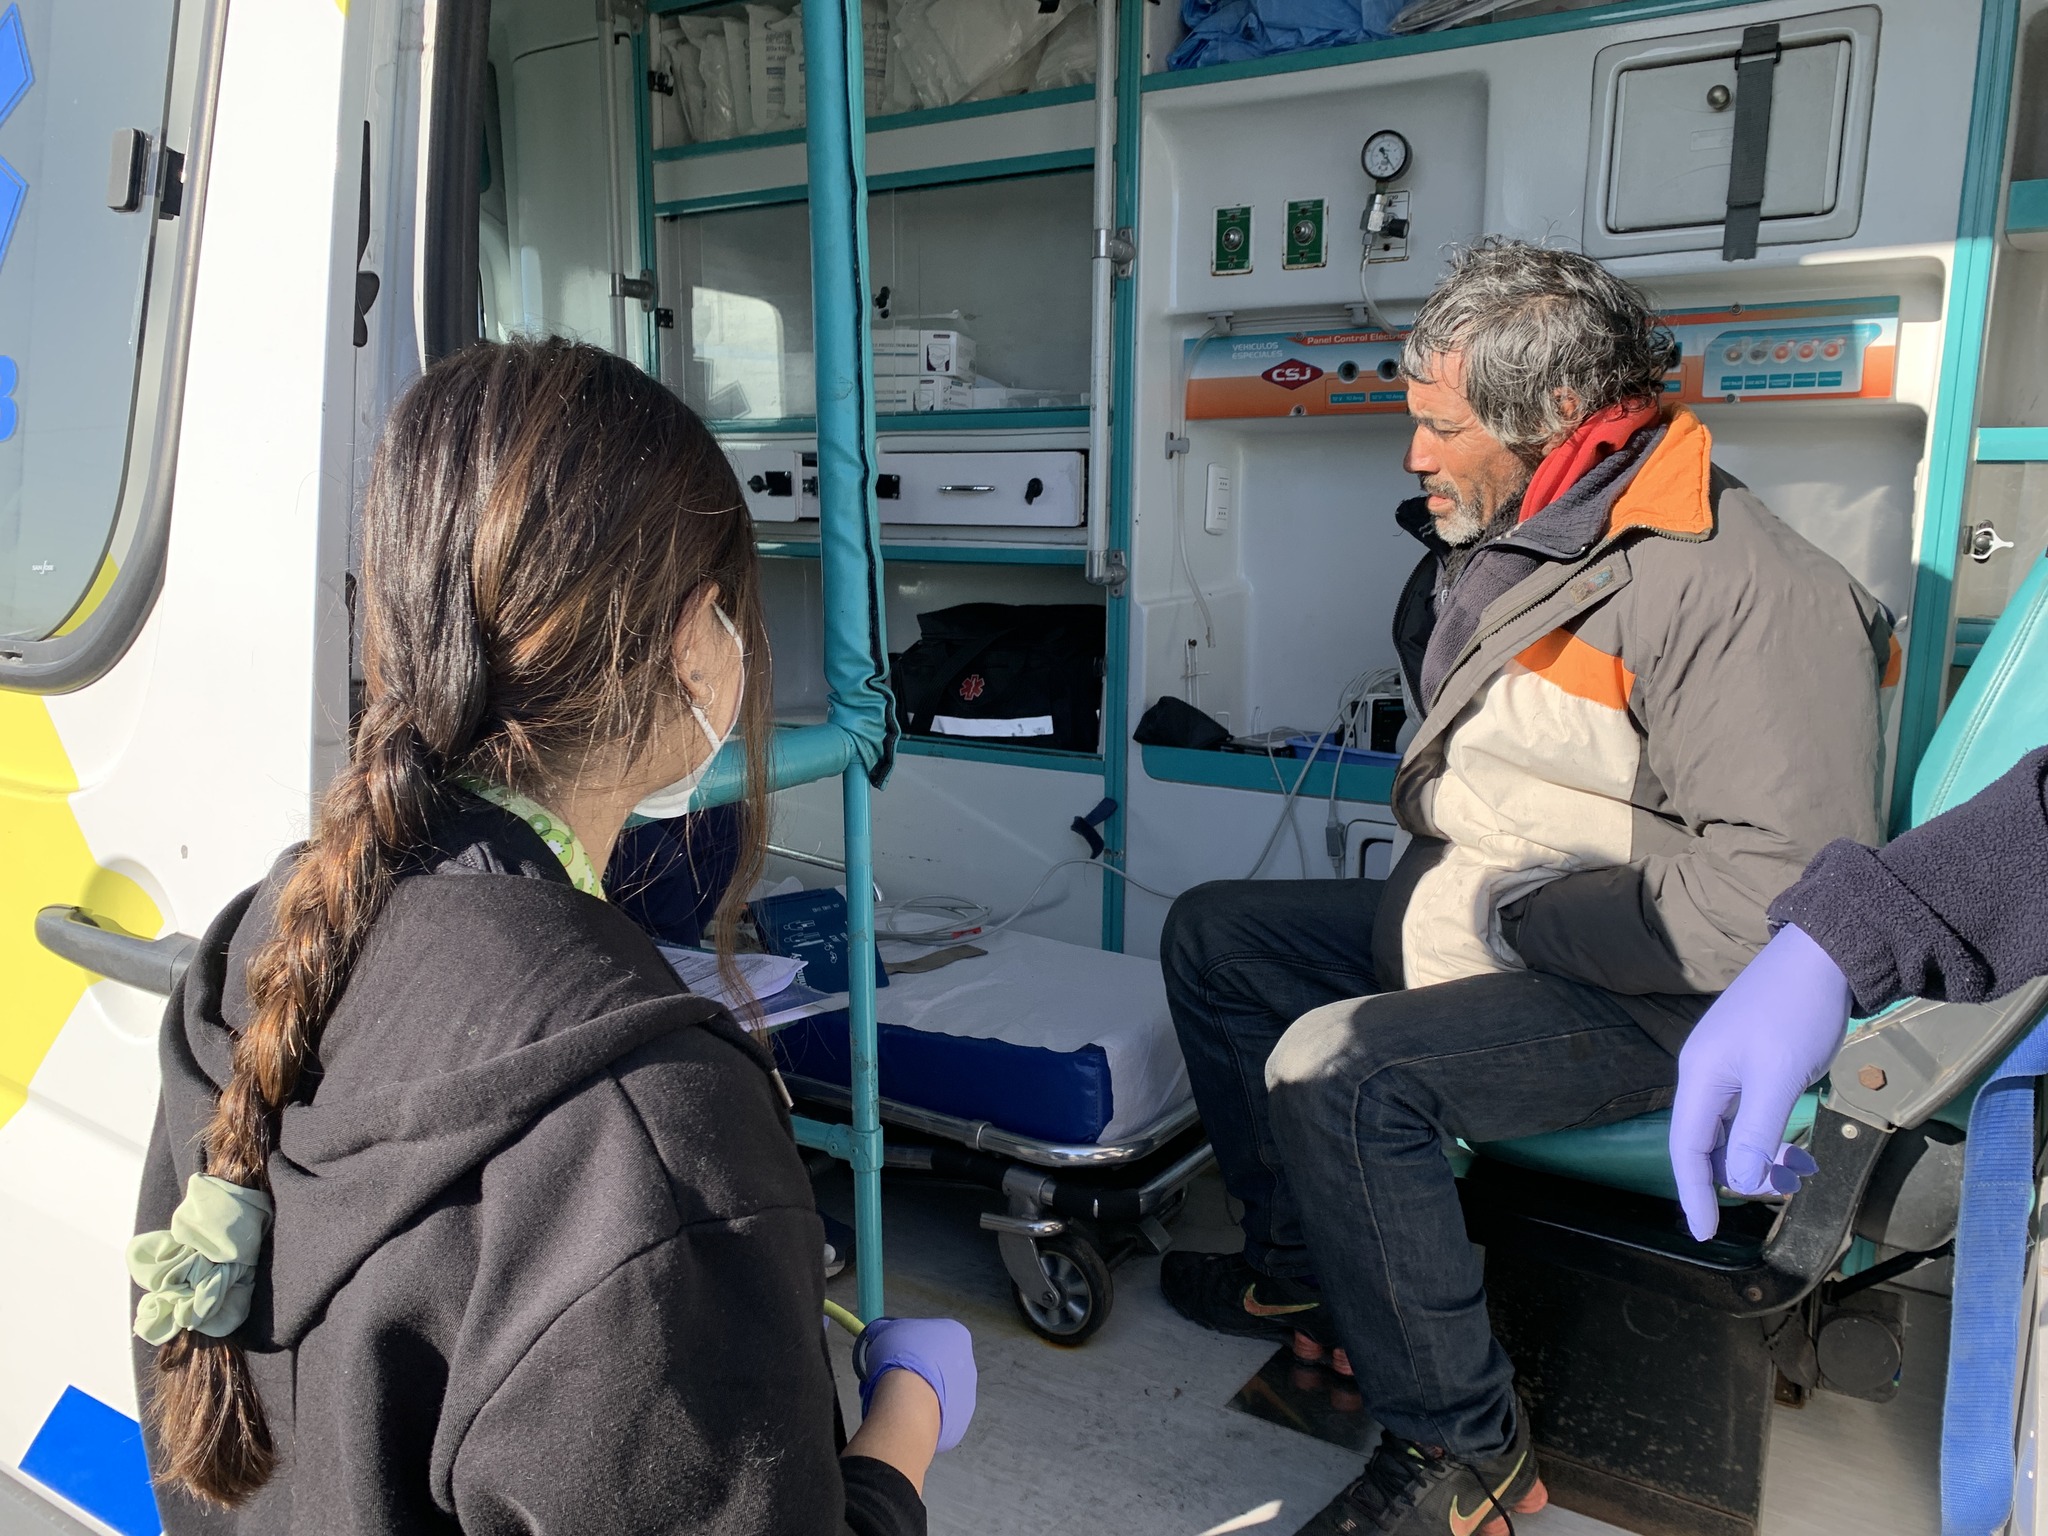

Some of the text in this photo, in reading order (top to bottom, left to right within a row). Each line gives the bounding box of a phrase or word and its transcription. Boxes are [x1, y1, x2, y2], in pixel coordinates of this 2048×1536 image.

[1307, 335, 1332, 345] Panel
[1334, 334, 1368, 343] Control
[1232, 350, 1283, 360] ESPECIALES
[1272, 367, 1312, 382] CSJ
